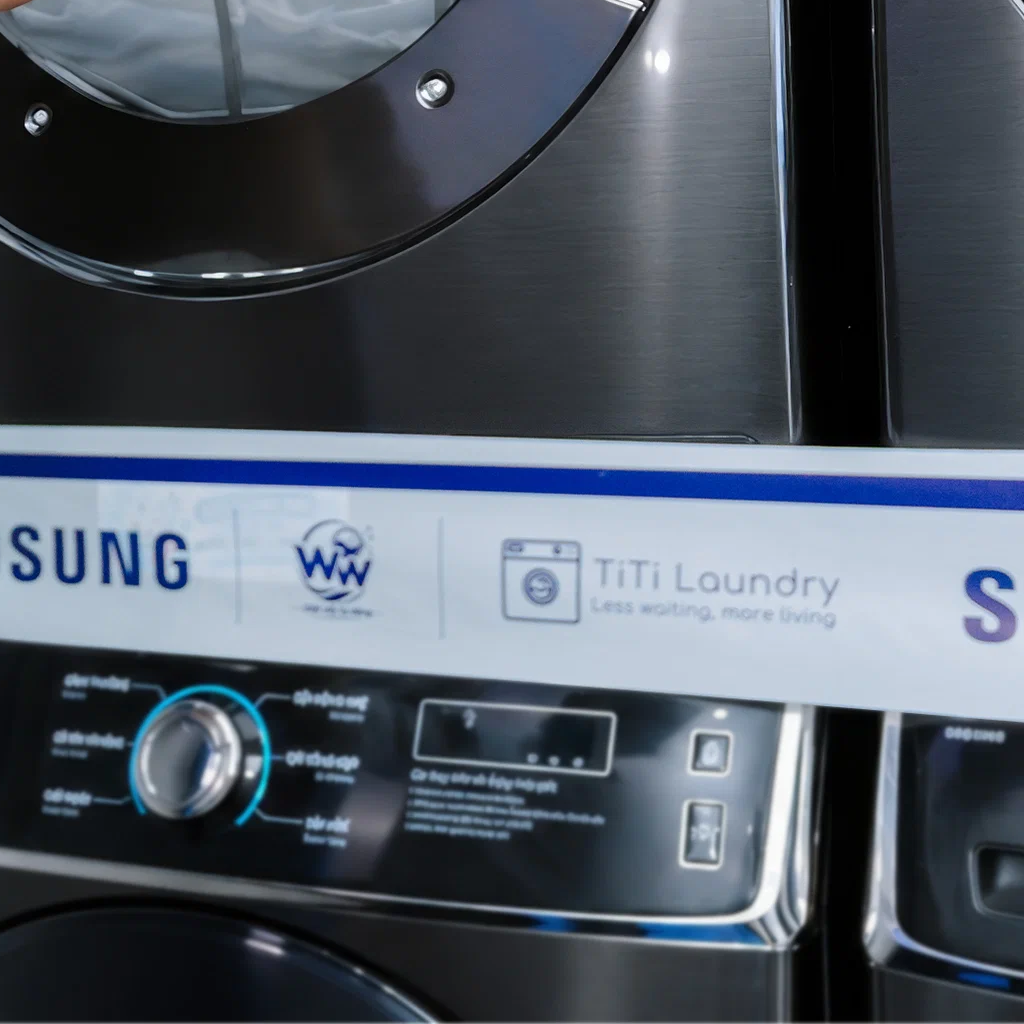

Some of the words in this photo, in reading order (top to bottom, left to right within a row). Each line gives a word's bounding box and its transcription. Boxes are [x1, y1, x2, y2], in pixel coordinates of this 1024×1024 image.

[594, 557, 660, 590] TiTi
[675, 562, 841, 607] Laundry
[590, 596, 635, 614] Less
[640, 601, 716, 623] waiting,
[721, 605, 775, 621] more
[779, 605, 837, 630] living
